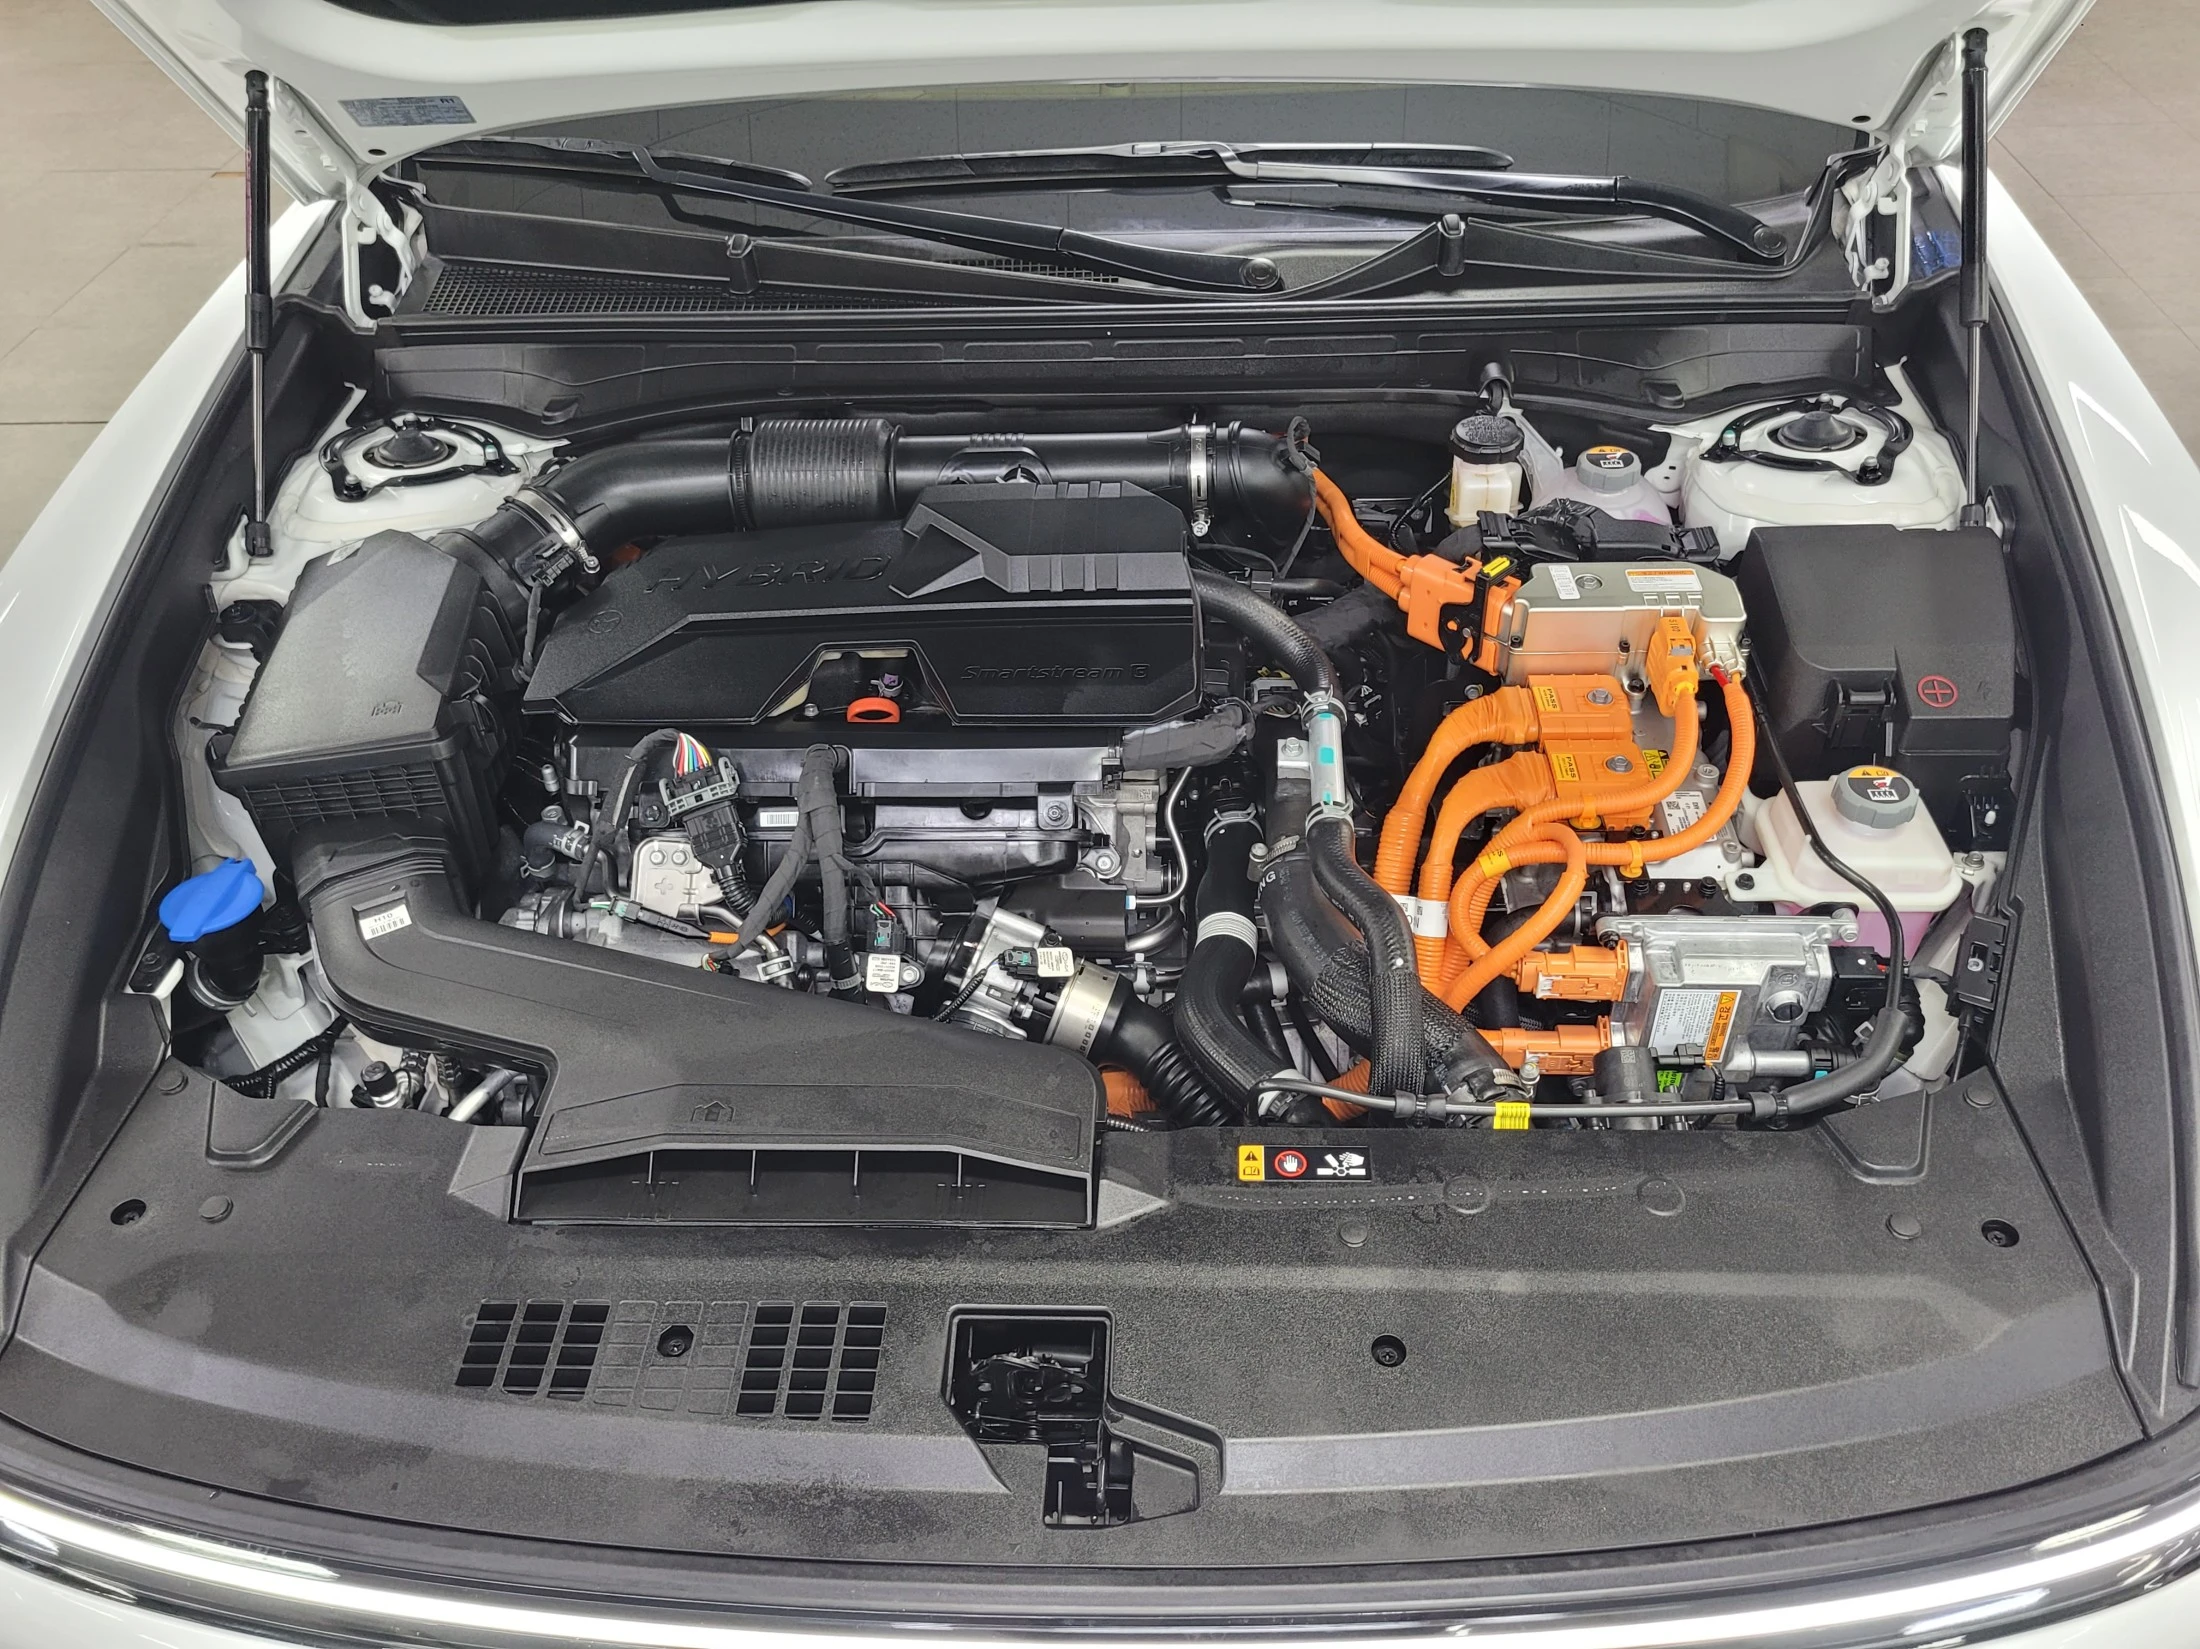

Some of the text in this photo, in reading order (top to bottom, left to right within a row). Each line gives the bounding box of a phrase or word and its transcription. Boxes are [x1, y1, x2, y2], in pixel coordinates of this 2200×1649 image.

[643, 553, 893, 594] HYBRID
[960, 664, 1124, 680] Smartstream
[1547, 688, 1558, 709] PASS
[1566, 756, 1577, 778] PASS
[1719, 1006, 1731, 1021] 경고
